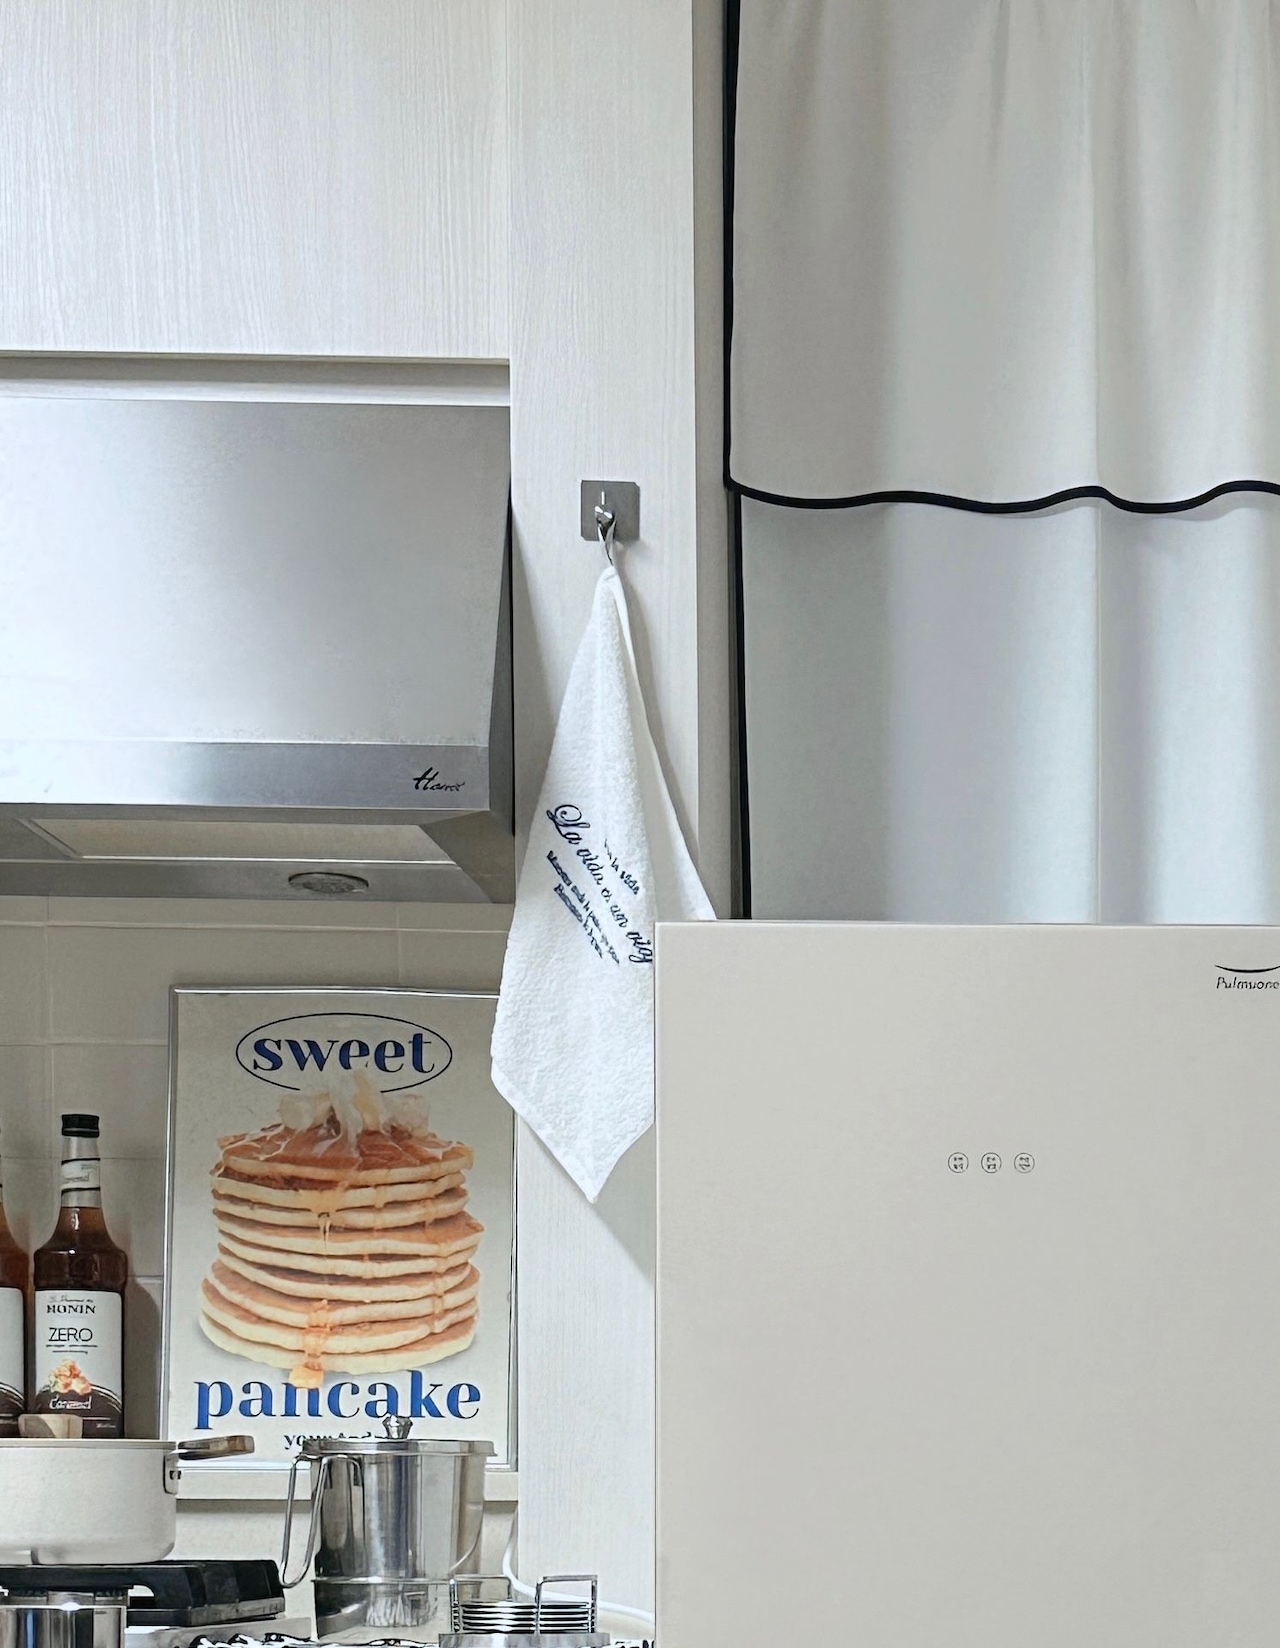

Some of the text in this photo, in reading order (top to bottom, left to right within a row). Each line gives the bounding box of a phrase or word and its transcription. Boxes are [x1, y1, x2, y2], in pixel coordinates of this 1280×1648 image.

[546, 803, 591, 845] La
[252, 1032, 436, 1074] sweet
[48, 1326, 93, 1342] ZERO
[192, 1369, 482, 1430] pancake
